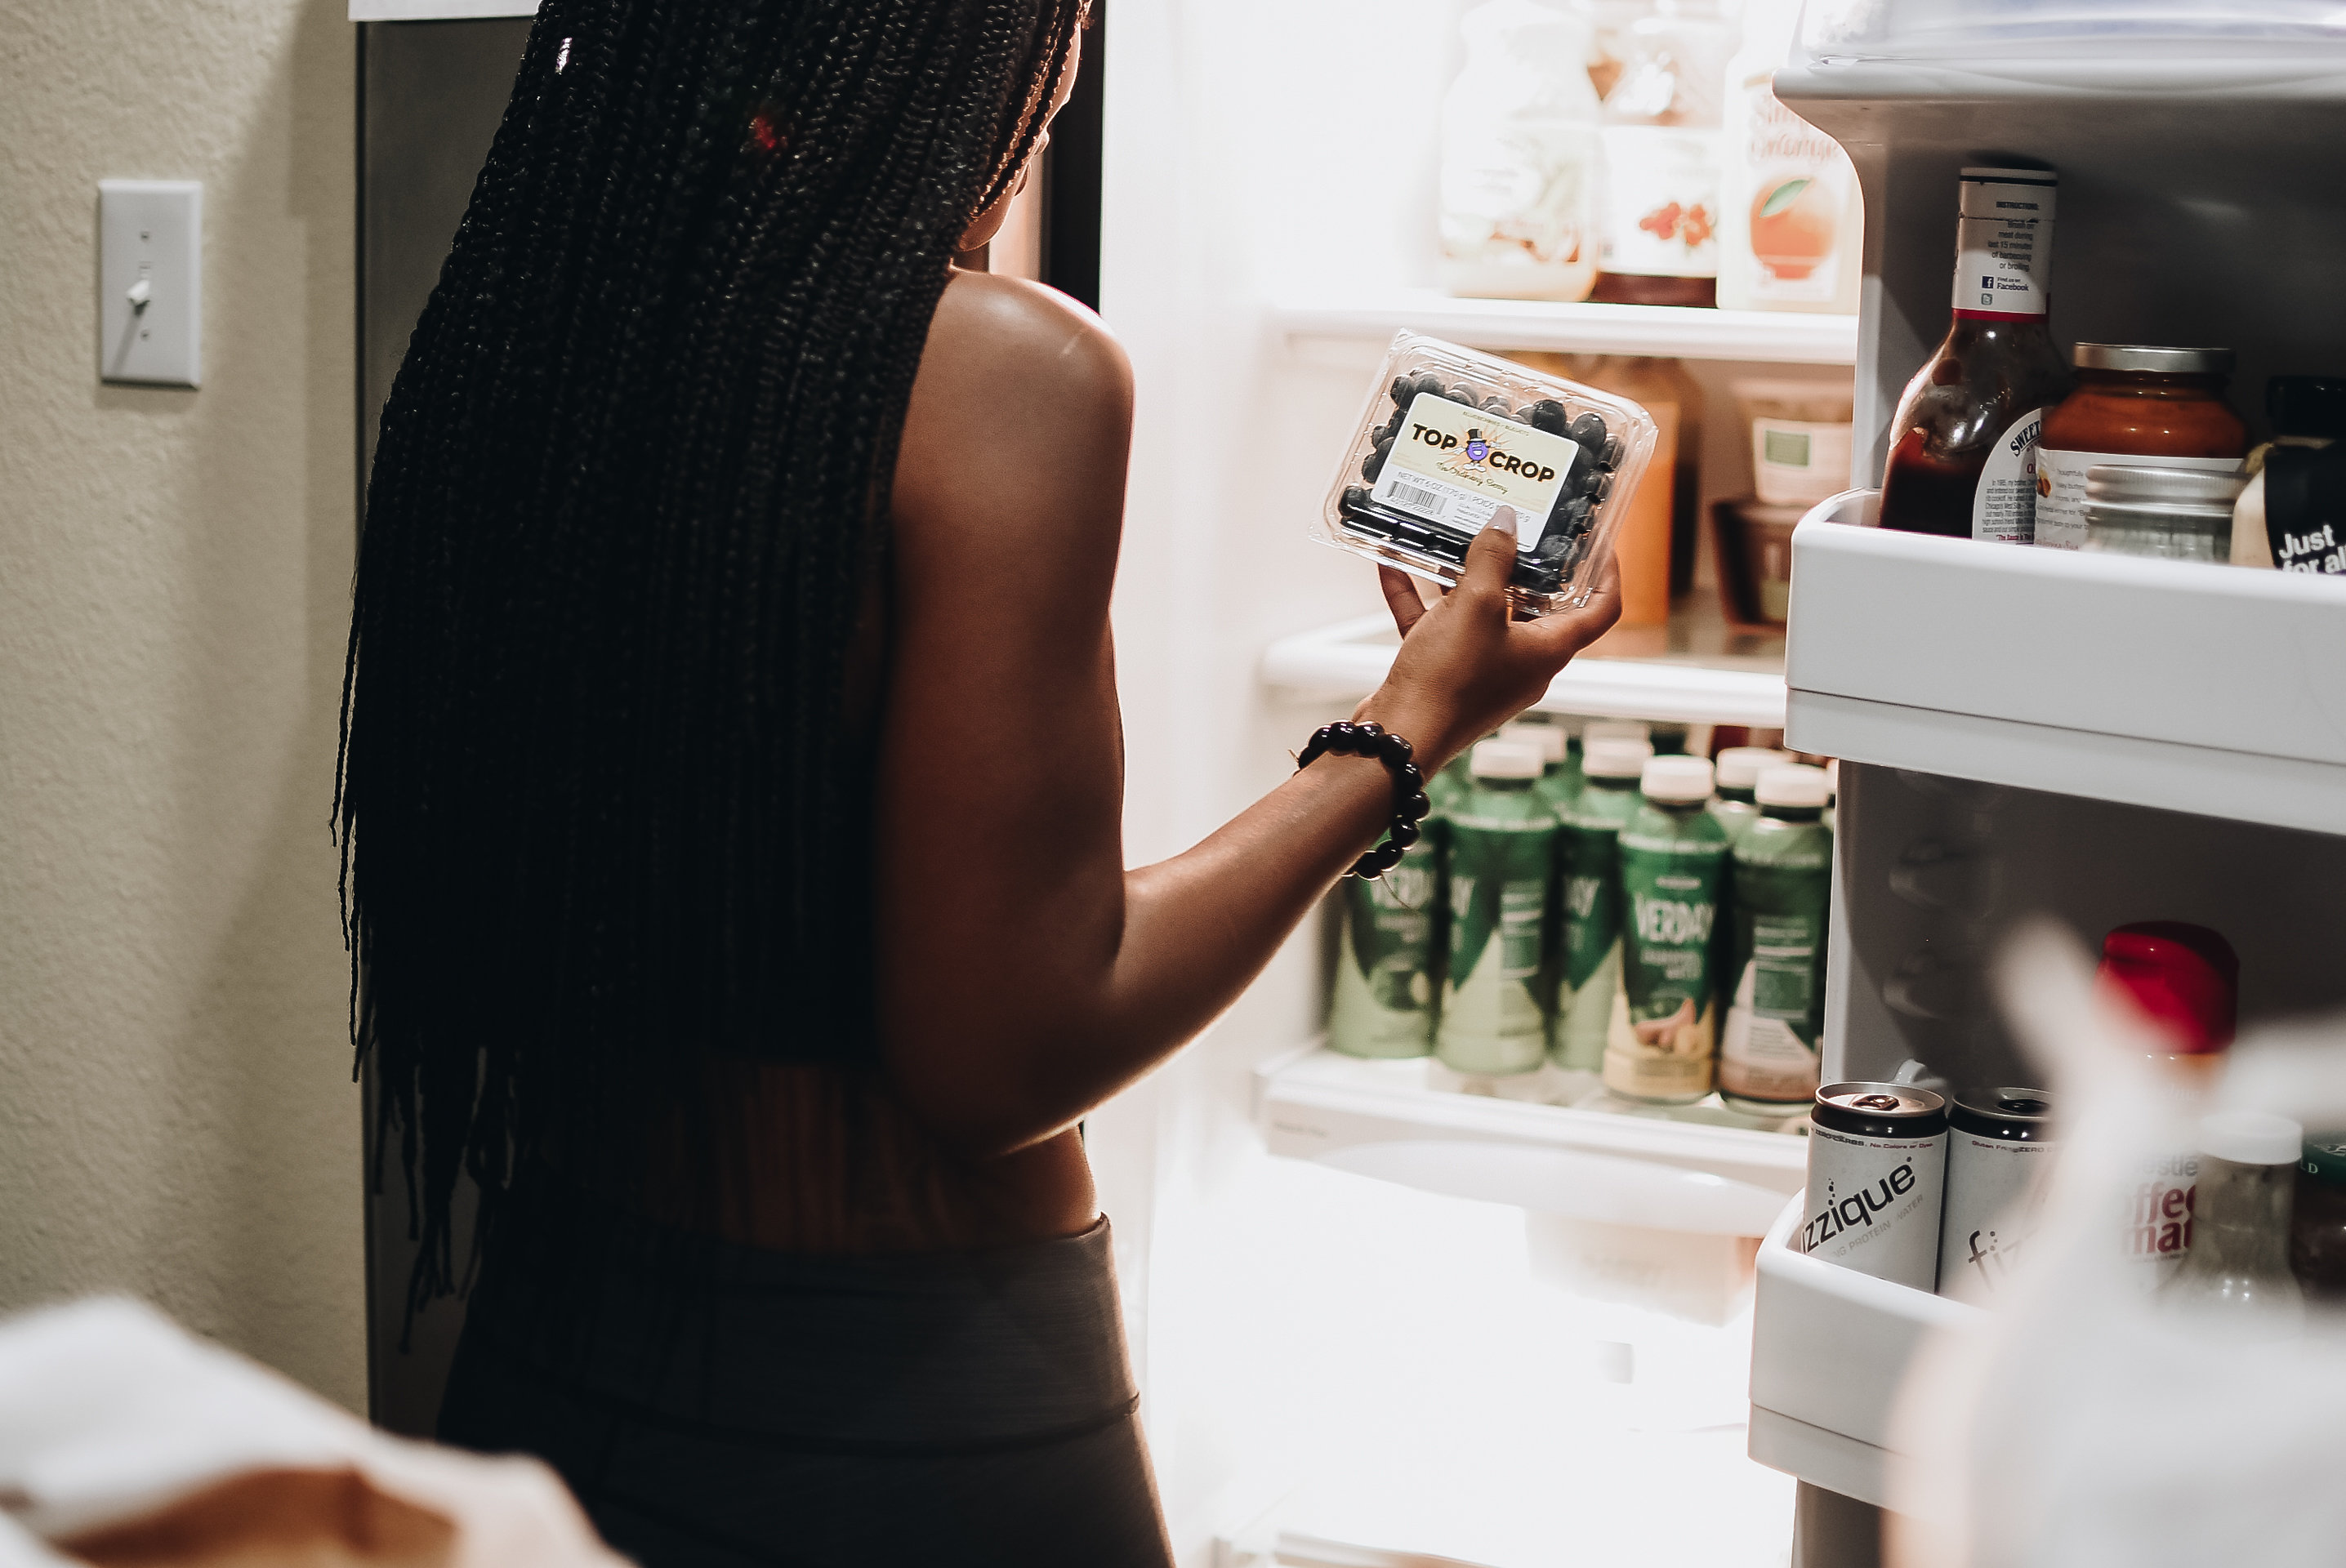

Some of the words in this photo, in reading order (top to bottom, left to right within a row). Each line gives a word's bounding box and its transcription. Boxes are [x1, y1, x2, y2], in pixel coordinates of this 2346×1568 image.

[1996, 283, 2029, 291] Facebook
[1412, 423, 1457, 450] TOP
[1489, 451, 1554, 482] CROP
[2010, 421, 2040, 457] SWEET
[2278, 524, 2335, 559] Just
[1849, 1220, 1891, 1251] PROTEIN
